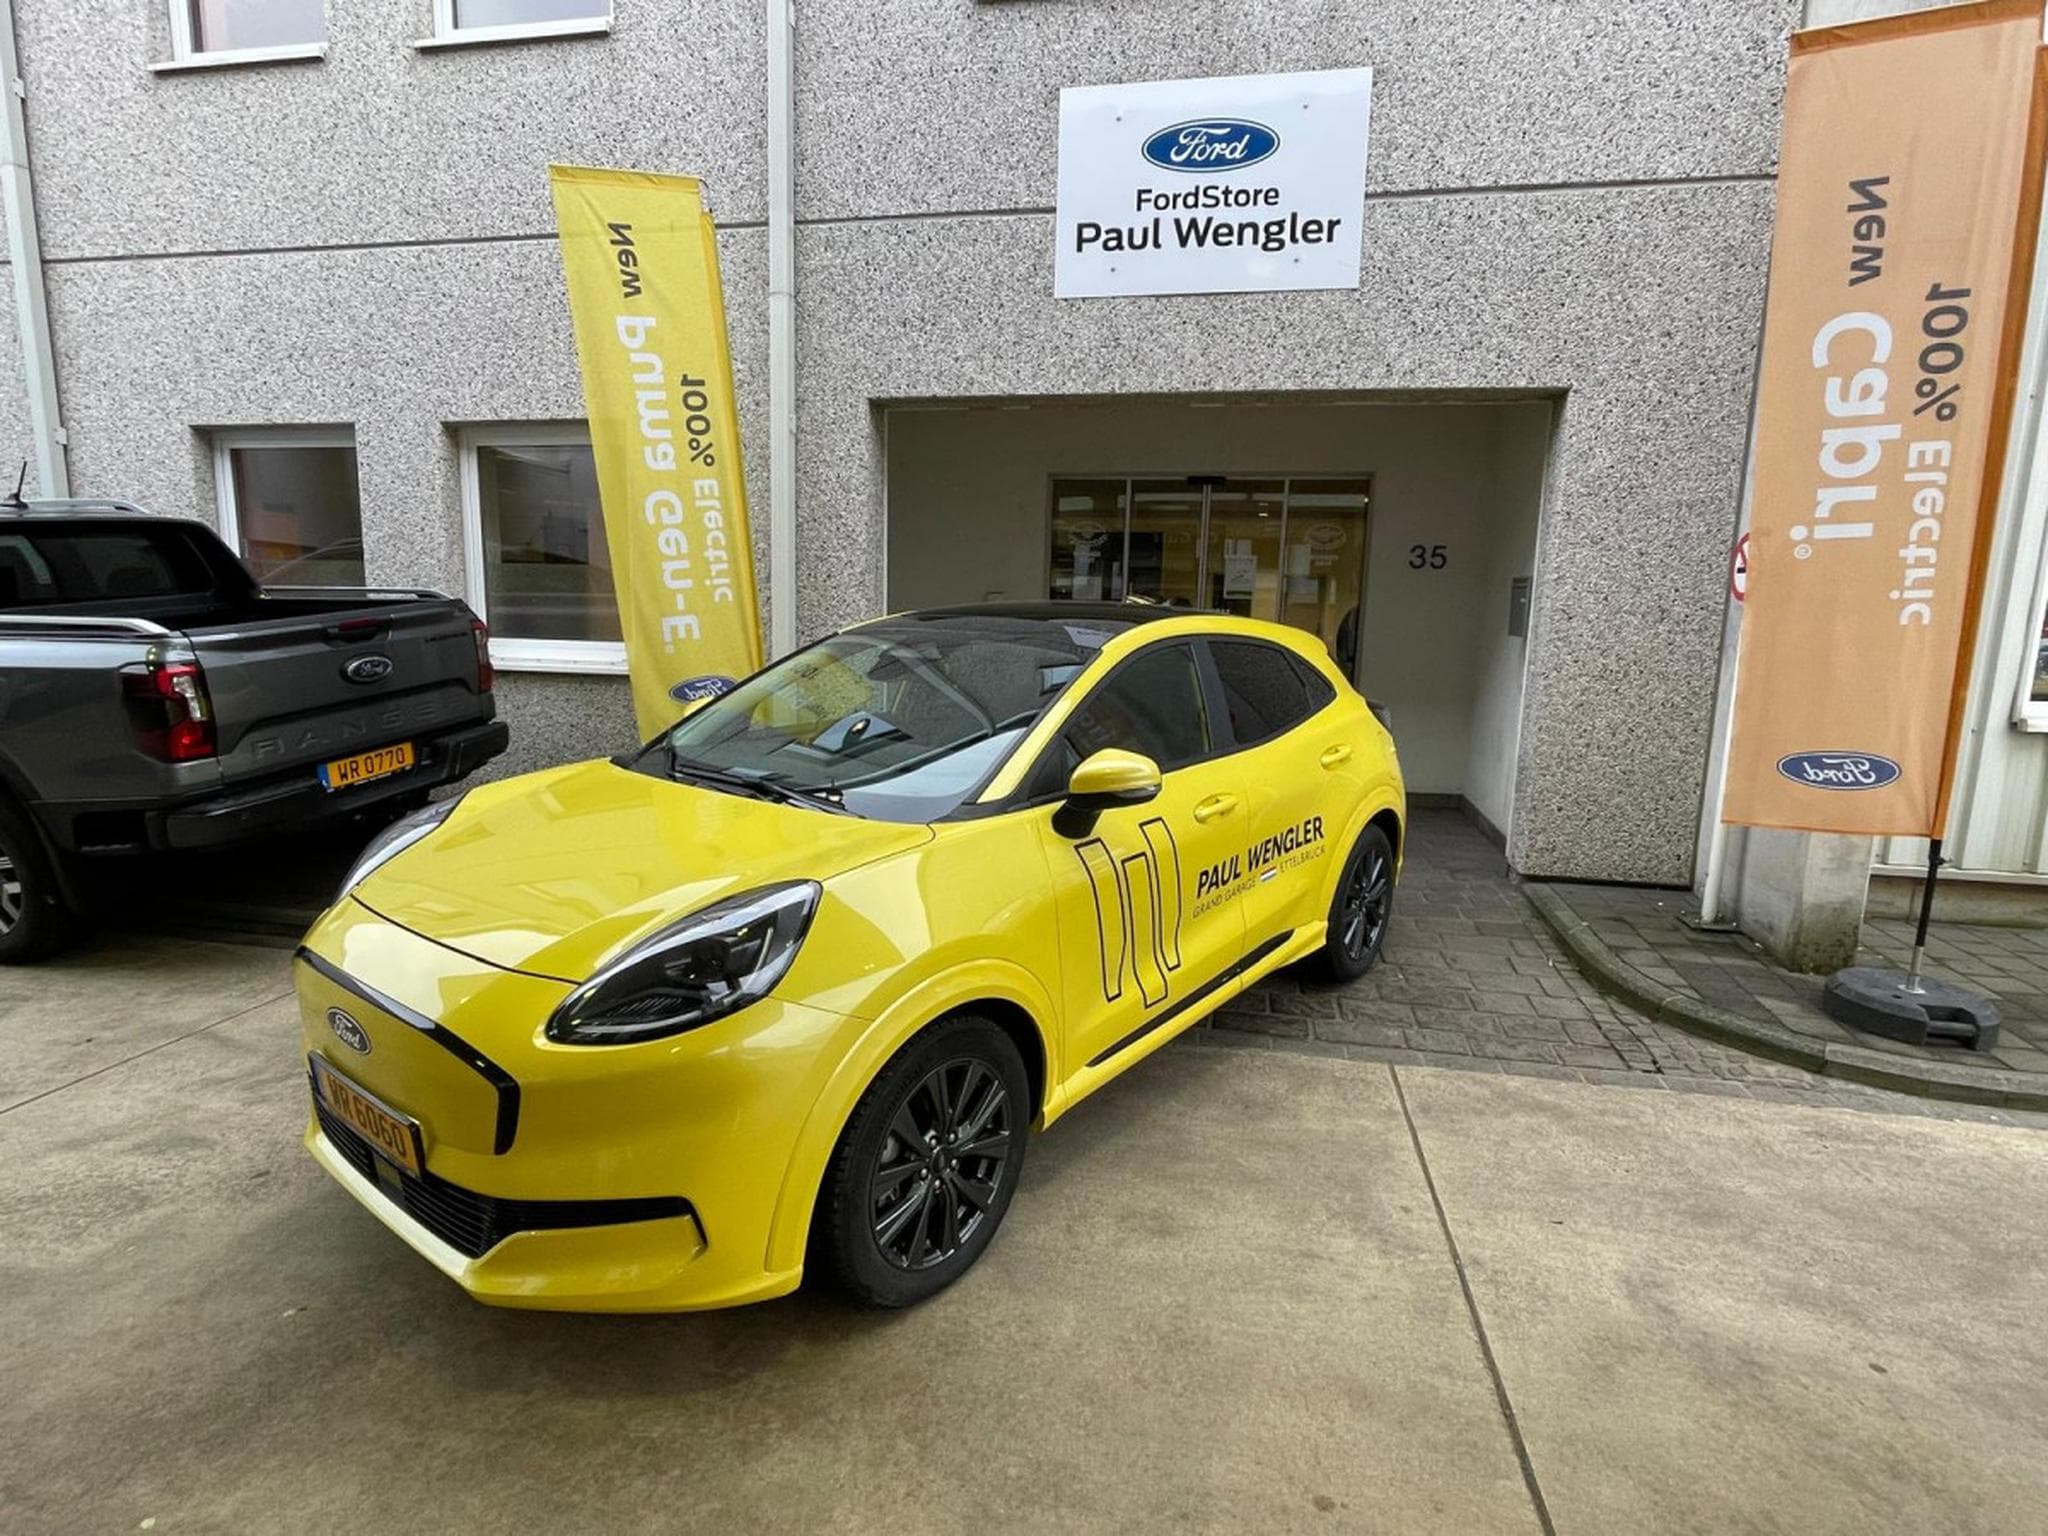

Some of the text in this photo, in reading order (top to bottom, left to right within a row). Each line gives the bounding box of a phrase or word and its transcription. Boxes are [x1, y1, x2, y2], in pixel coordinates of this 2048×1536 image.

[1170, 125, 1251, 163] Ford
[1136, 185, 1280, 212] FordStore
[1076, 212, 1341, 253] Paul Wengler
[1409, 545, 1448, 570] 35
[337, 747, 405, 782] WR 0770
[1197, 815, 1324, 899] PAUL WENGLER
[335, 1014, 362, 1049] Ford
[352, 1095, 406, 1158] 6060
